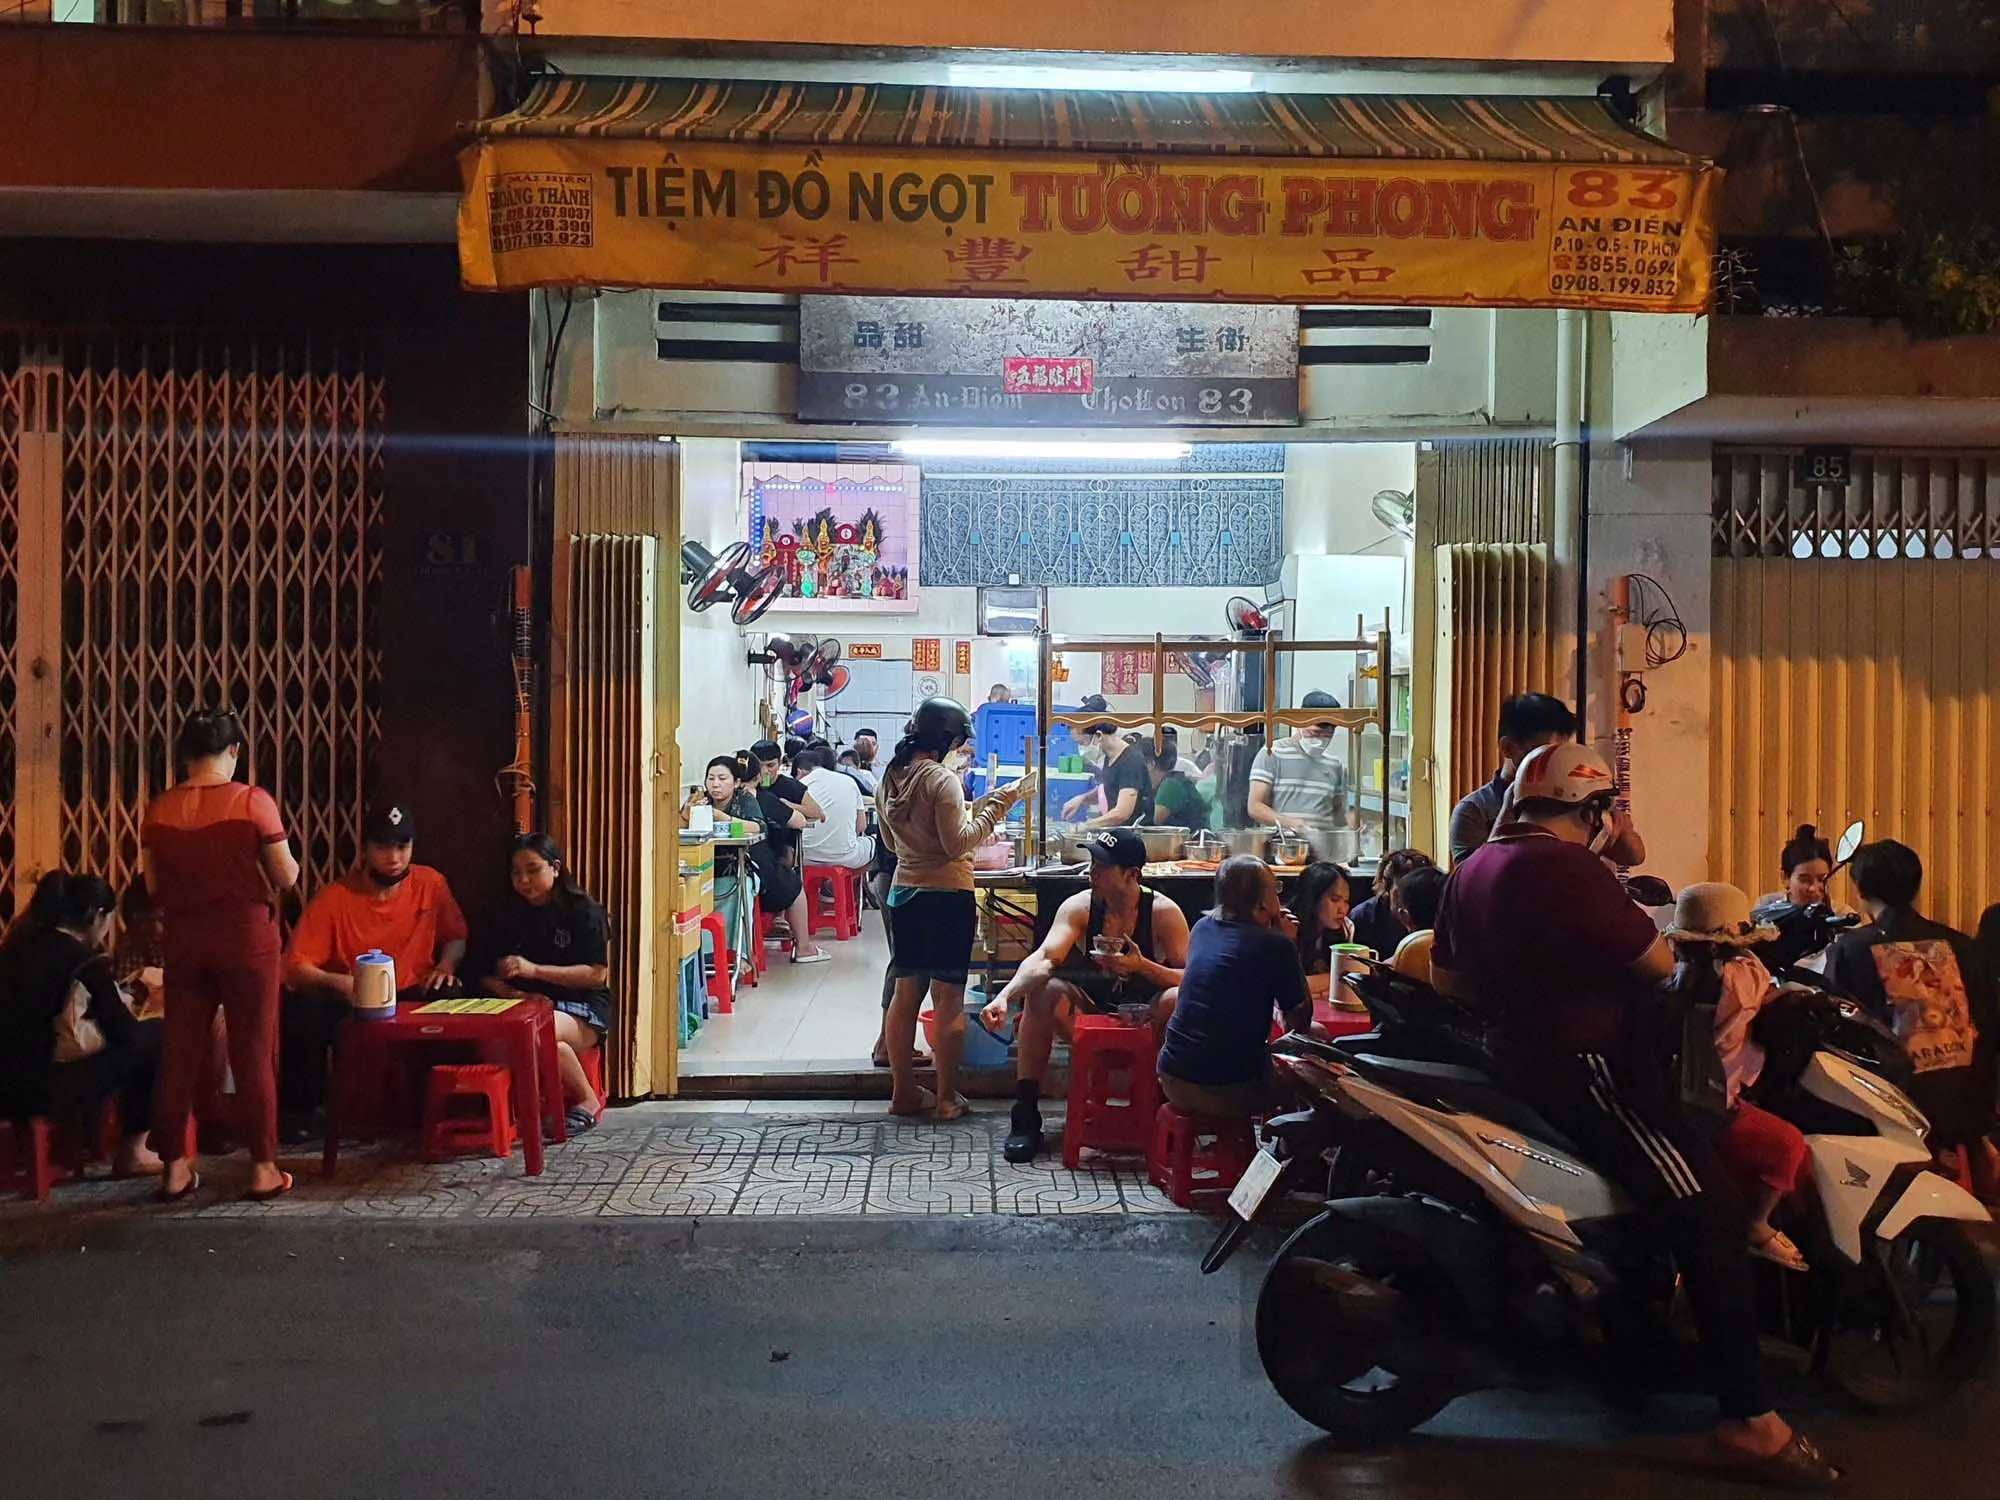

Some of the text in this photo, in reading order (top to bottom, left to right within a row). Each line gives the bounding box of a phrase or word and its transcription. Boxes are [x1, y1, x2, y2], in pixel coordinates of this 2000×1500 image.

[606, 152, 737, 232] TIỆM
[754, 148, 831, 222] ĐỒ
[848, 171, 994, 237] NGỌT
[1280, 176, 1540, 242] PHONG
[1567, 169, 1681, 210] 83
[1558, 216, 1602, 233] AN
[1575, 255, 1675, 277] 3855.0694
[1552, 274, 1676, 296] 0908.199.832
[843, 382, 899, 410] 83
[1198, 387, 1253, 415] 83
[1813, 456, 1843, 478] 85
